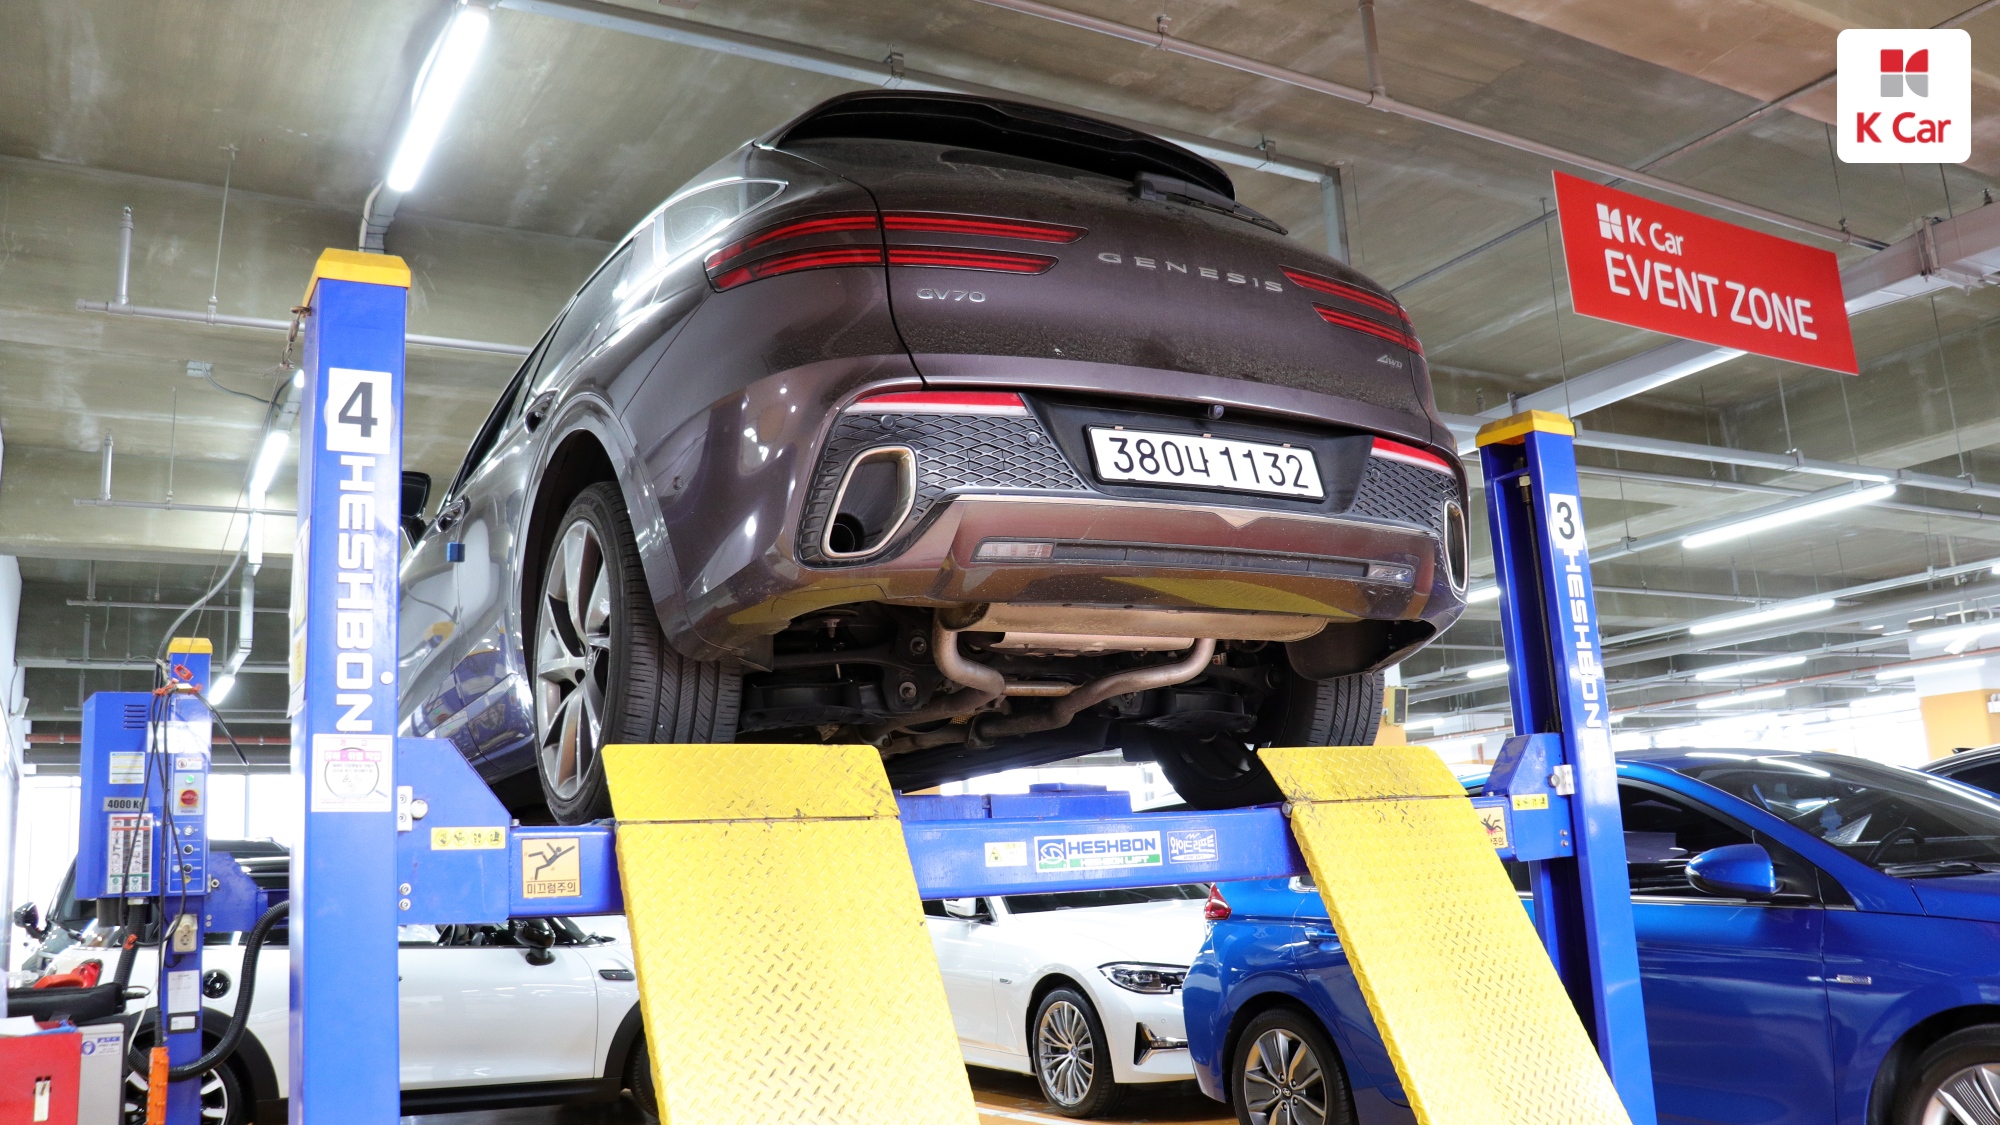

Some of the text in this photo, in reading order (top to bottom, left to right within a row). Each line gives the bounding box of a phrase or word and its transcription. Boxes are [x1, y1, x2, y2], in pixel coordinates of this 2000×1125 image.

[1626, 215, 1684, 256] K Car
[1098, 252, 1283, 292] GENESIS
[916, 288, 986, 303] GV70
[1604, 248, 1818, 341] EVENT ZONE
[338, 381, 378, 438] 4
[1219, 446, 1309, 489] 1132
[1556, 501, 1575, 540] 3
[336, 454, 376, 732] HESHBON
[1563, 549, 1602, 729] HESHBON
[107, 799, 132, 809] 4000
[1067, 837, 1156, 854] HESHBON
[526, 881, 577, 895] 미끄럼주의
